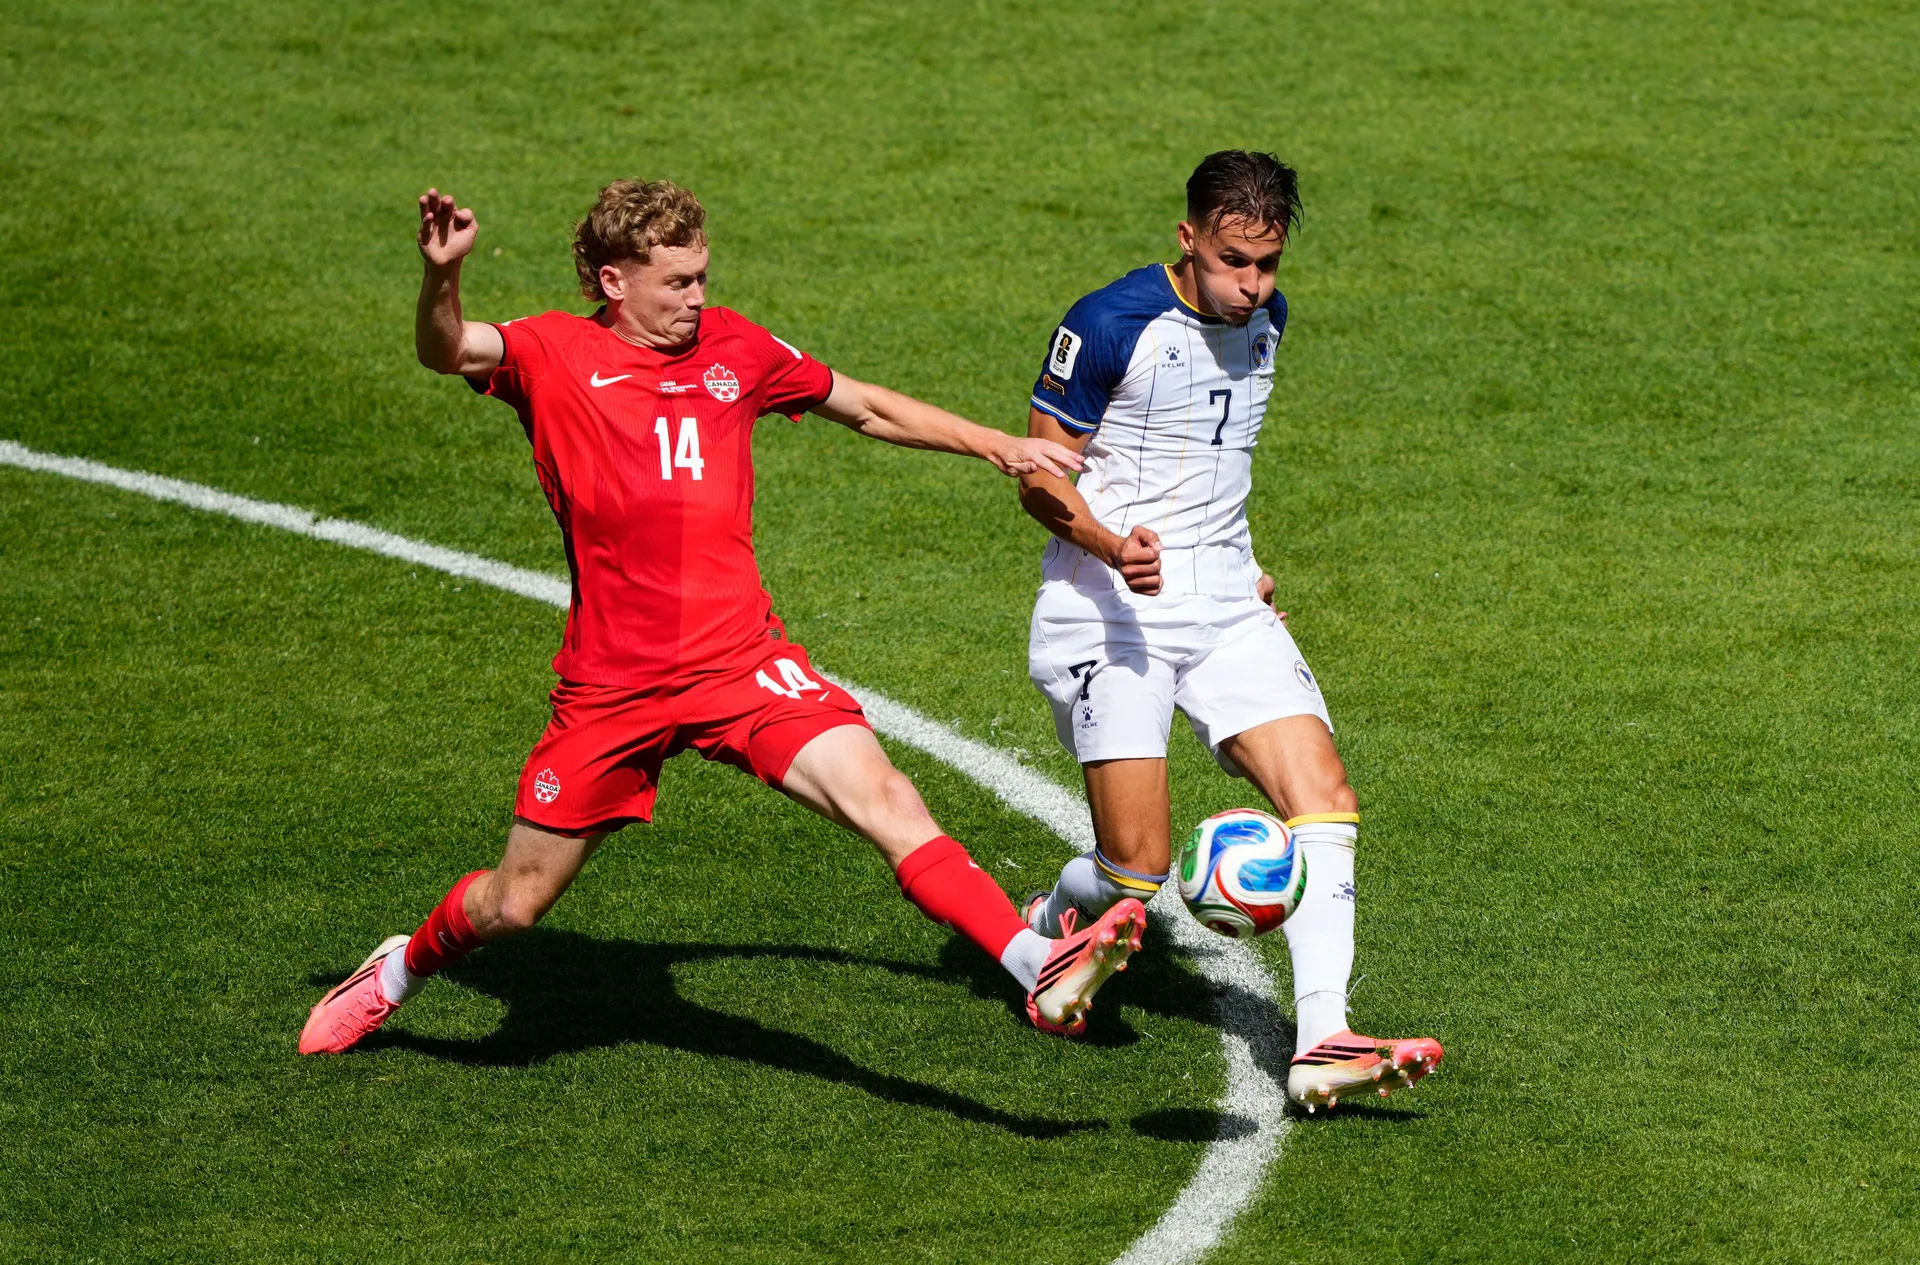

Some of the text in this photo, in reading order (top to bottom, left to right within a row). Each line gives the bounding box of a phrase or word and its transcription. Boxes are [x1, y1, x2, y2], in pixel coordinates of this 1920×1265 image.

[1209, 388, 1232, 446] 7
[653, 417, 704, 480] 14
[755, 658, 822, 700] 14
[1068, 659, 1098, 700] 7
[535, 780, 558, 792] CANADA
[1332, 893, 1355, 902] KEL
